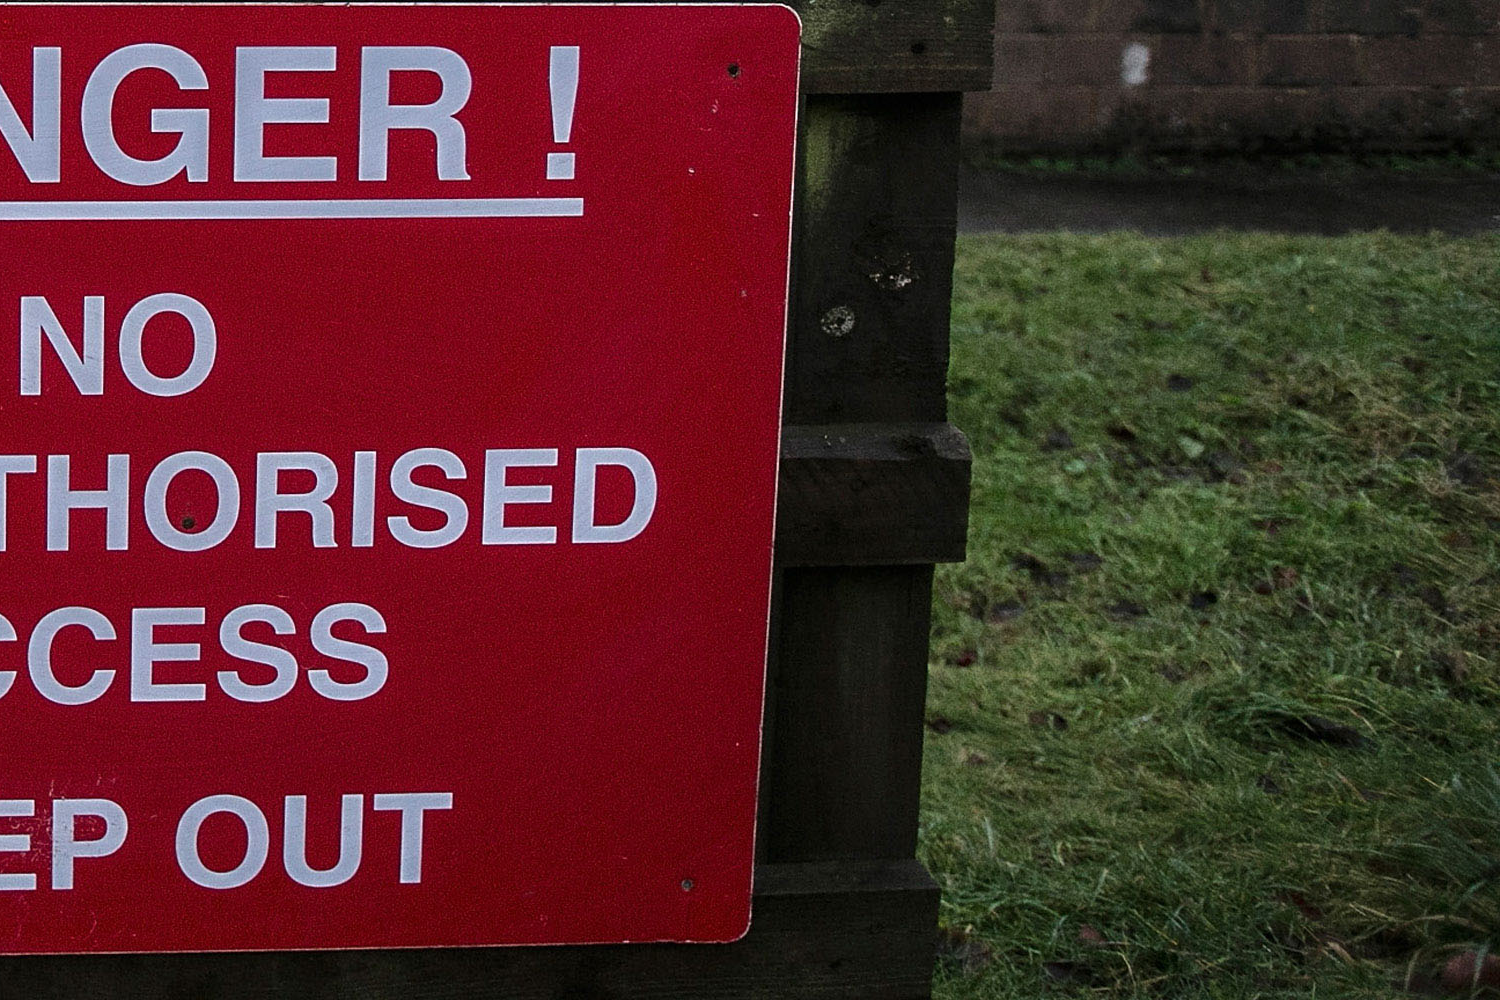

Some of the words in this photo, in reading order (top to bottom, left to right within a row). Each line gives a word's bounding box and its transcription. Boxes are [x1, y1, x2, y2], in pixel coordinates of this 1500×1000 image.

[546, 45, 581, 181] !
[20, 292, 217, 397] NO
[175, 792, 454, 890] OUT
